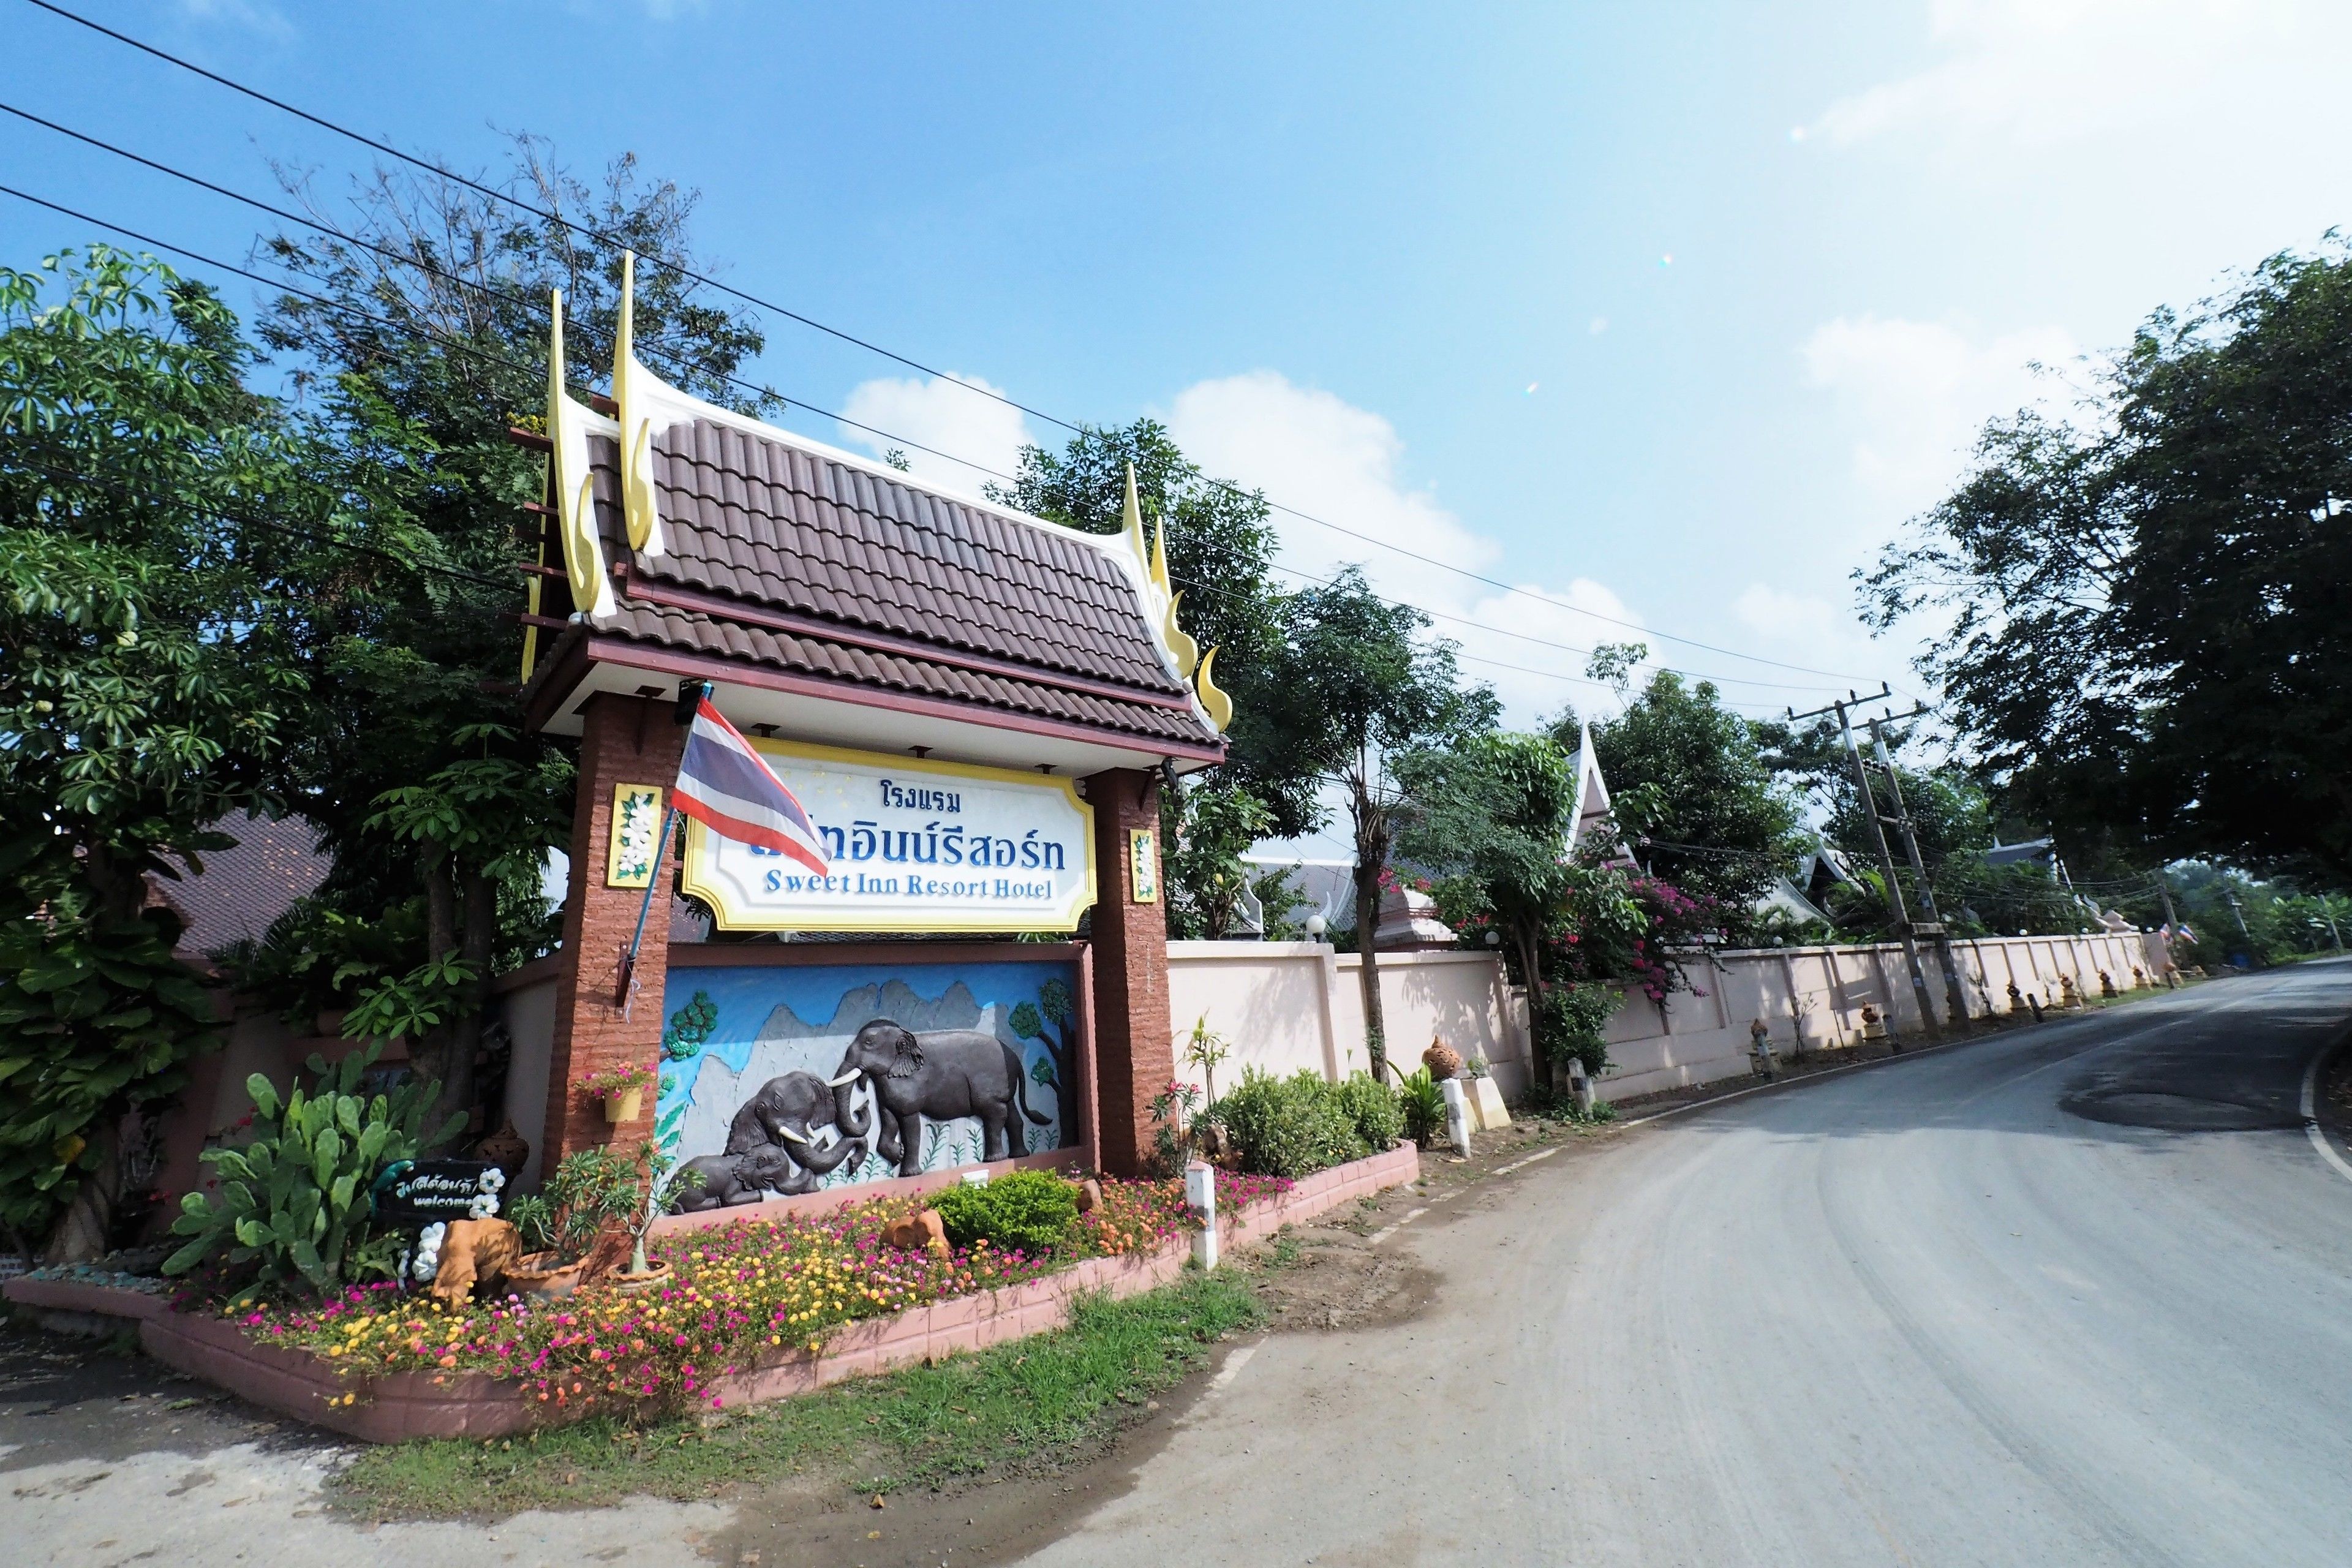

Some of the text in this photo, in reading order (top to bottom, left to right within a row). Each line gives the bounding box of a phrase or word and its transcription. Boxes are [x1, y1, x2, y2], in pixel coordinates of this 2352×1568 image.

[880, 779, 961, 813] โรงแรม
[766, 869, 1052, 898] Sweet Inn Resort Hotel
[413, 1194, 473, 1207] welcome
